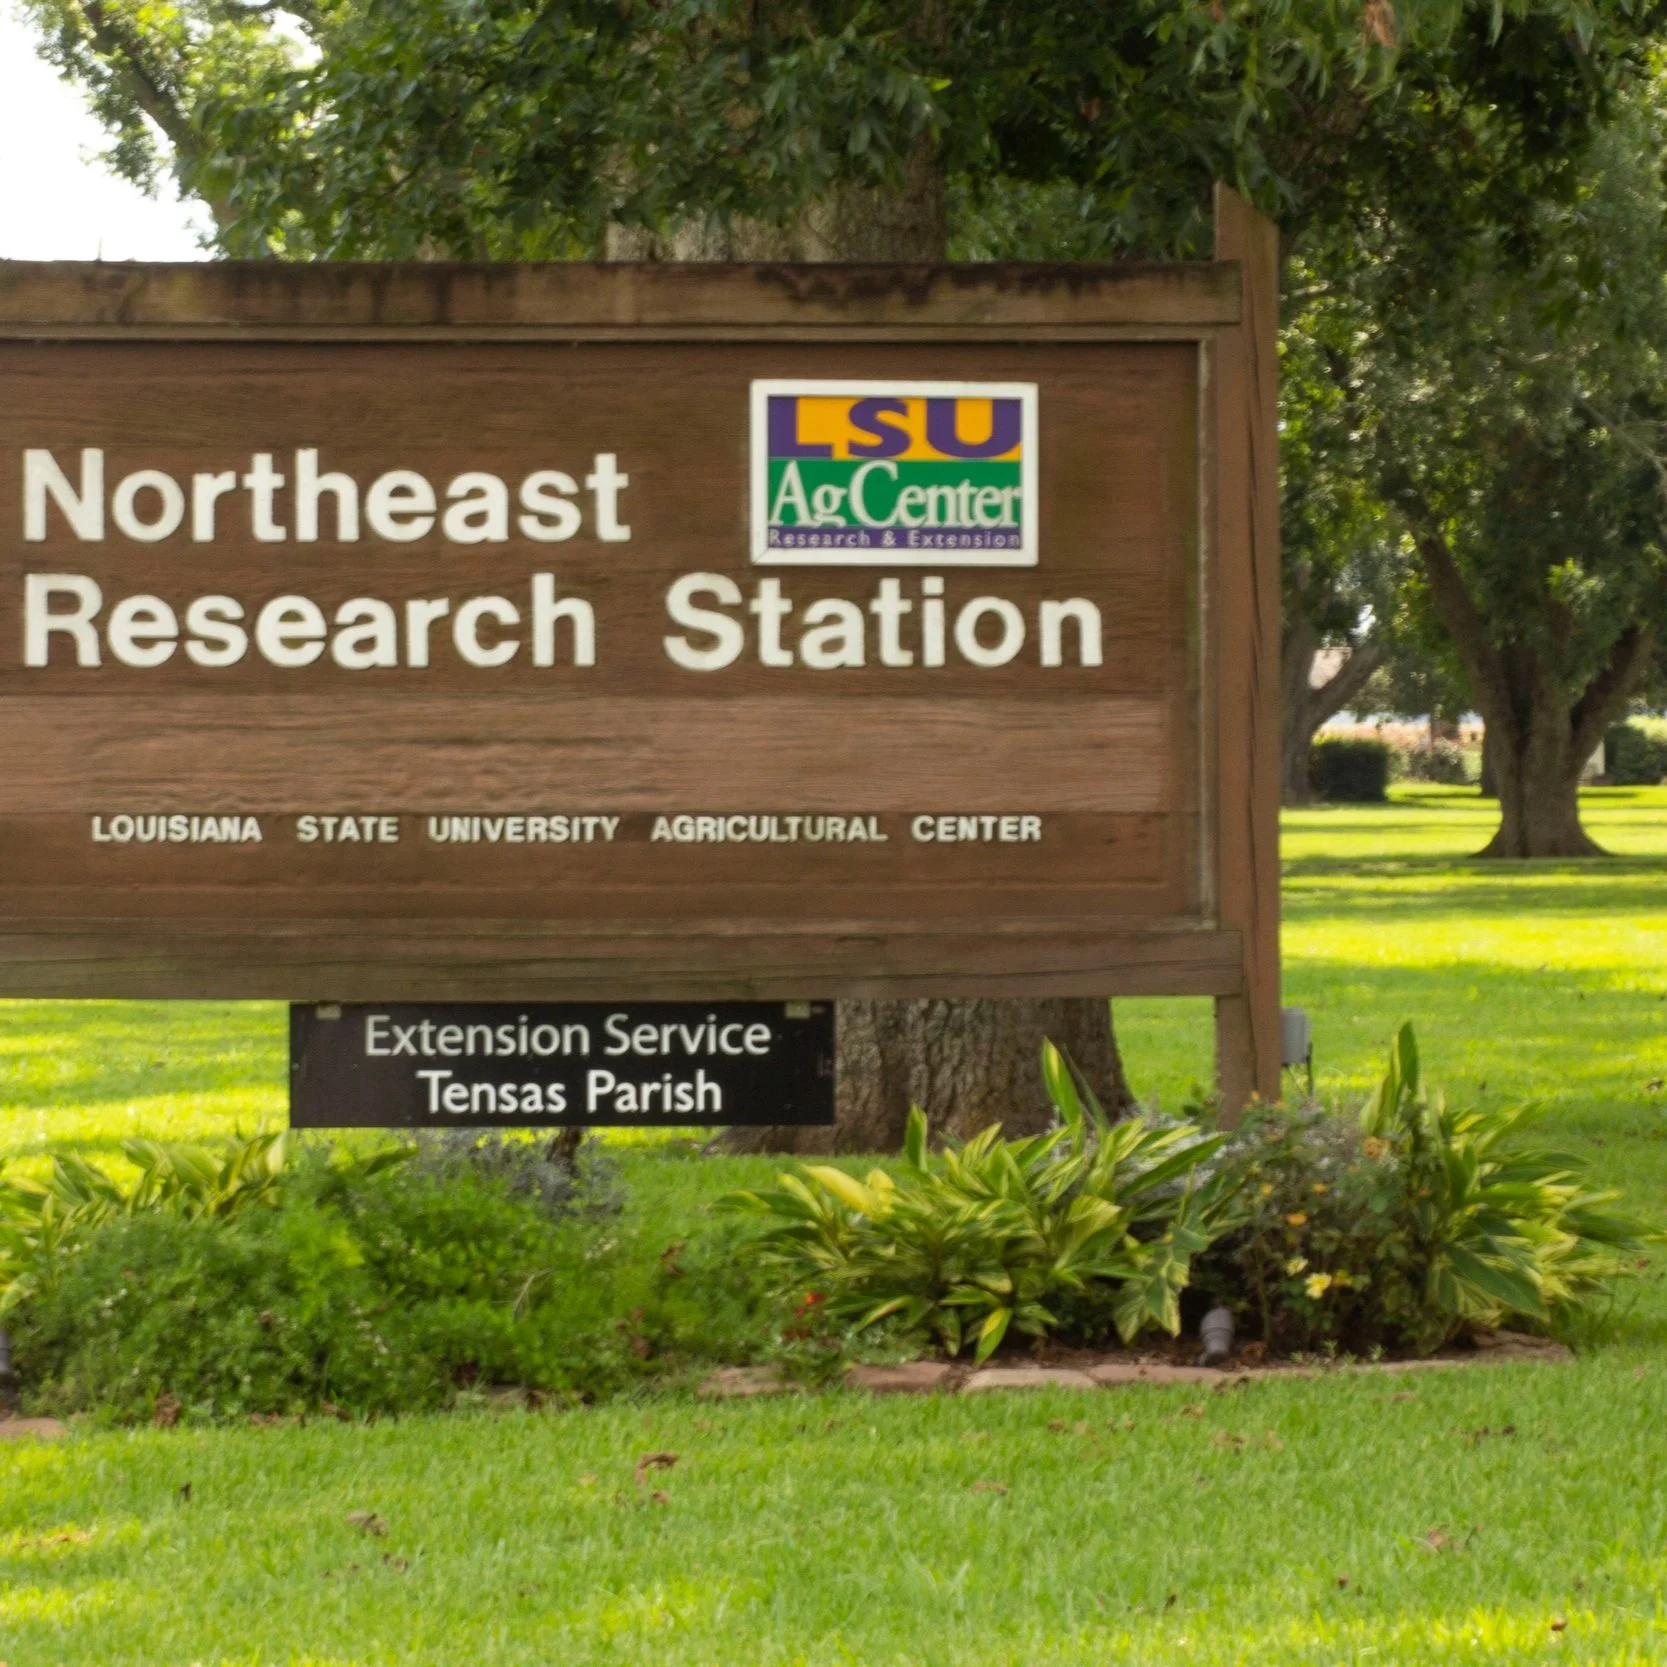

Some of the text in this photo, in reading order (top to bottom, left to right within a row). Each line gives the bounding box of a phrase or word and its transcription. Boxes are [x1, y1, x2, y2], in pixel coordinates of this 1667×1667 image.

[768, 396, 1022, 458] LSU
[23, 447, 631, 544] Northeast
[768, 460, 1022, 528] AgCenter
[769, 530, 1021, 547] Research & Extension
[24, 572, 1103, 671] Research Station
[91, 815, 1042, 843] LOUISIANA STATE UNIVERSITY AGRICULTURAL CENTER
[365, 1013, 772, 1057] Extension Service
[416, 1068, 723, 1114] Tensas Parish
